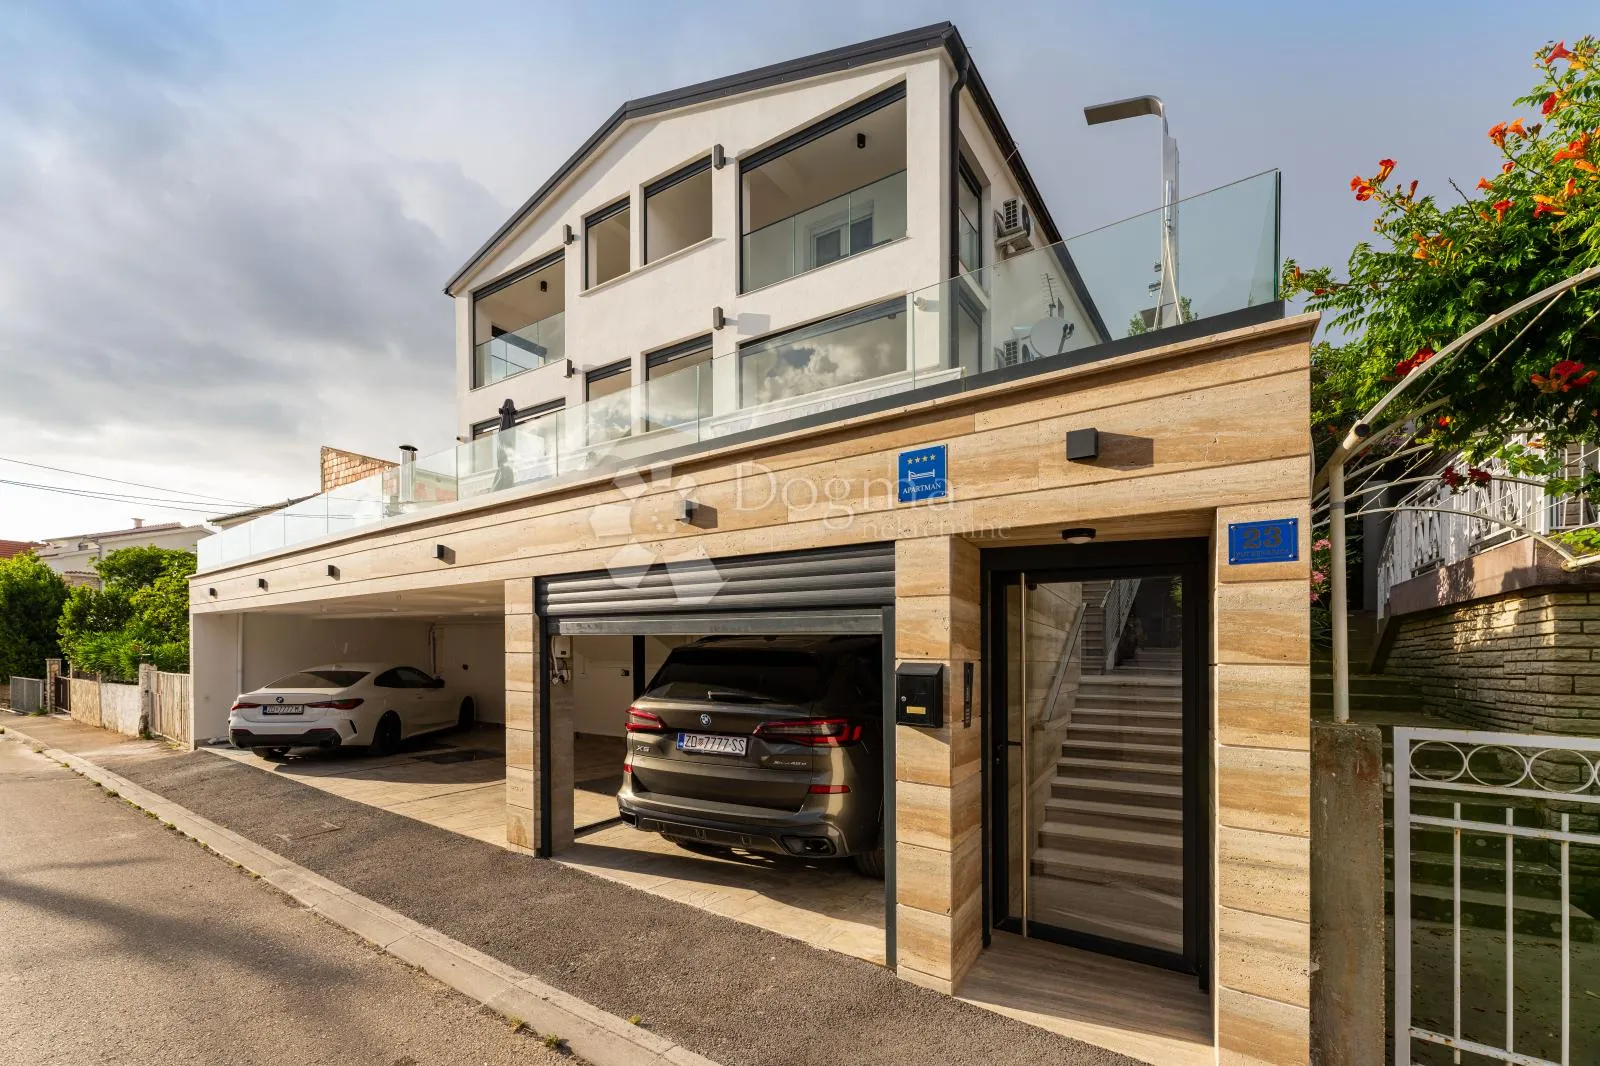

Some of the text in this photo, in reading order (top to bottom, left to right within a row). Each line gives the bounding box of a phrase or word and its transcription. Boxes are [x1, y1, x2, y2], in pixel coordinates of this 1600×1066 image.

[902, 482, 943, 495] APARTMAN
[1243, 525, 1282, 549] 23
[685, 735, 698, 748] ZD
